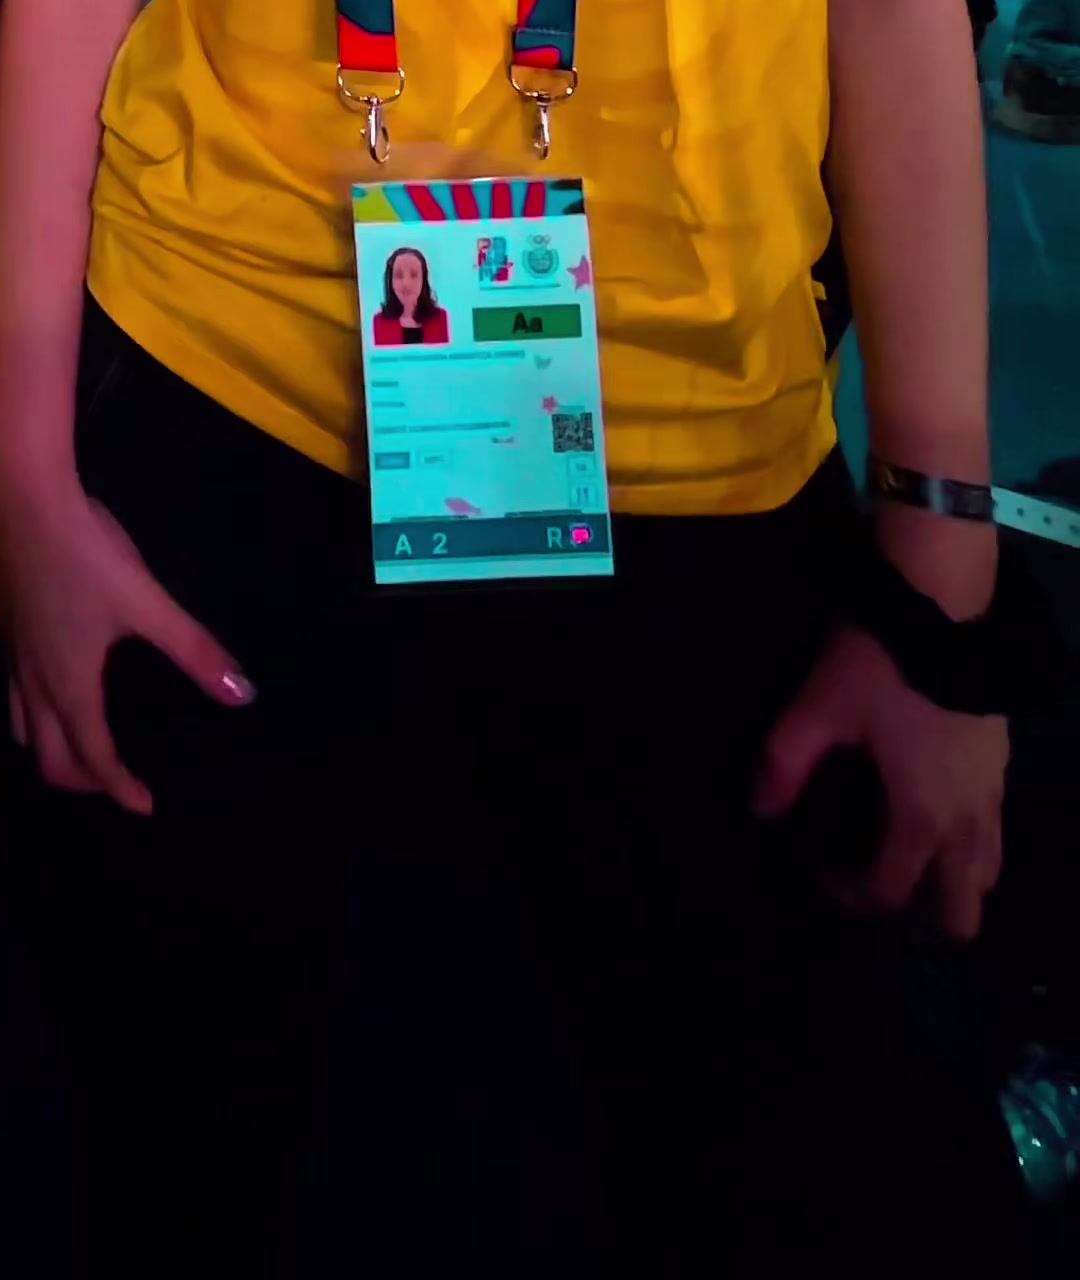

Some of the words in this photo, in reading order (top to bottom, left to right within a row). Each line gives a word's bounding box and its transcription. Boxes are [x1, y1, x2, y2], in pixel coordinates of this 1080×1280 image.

[511, 311, 544, 335] Aa
[394, 533, 413, 556] A
[431, 532, 449, 555] 2
